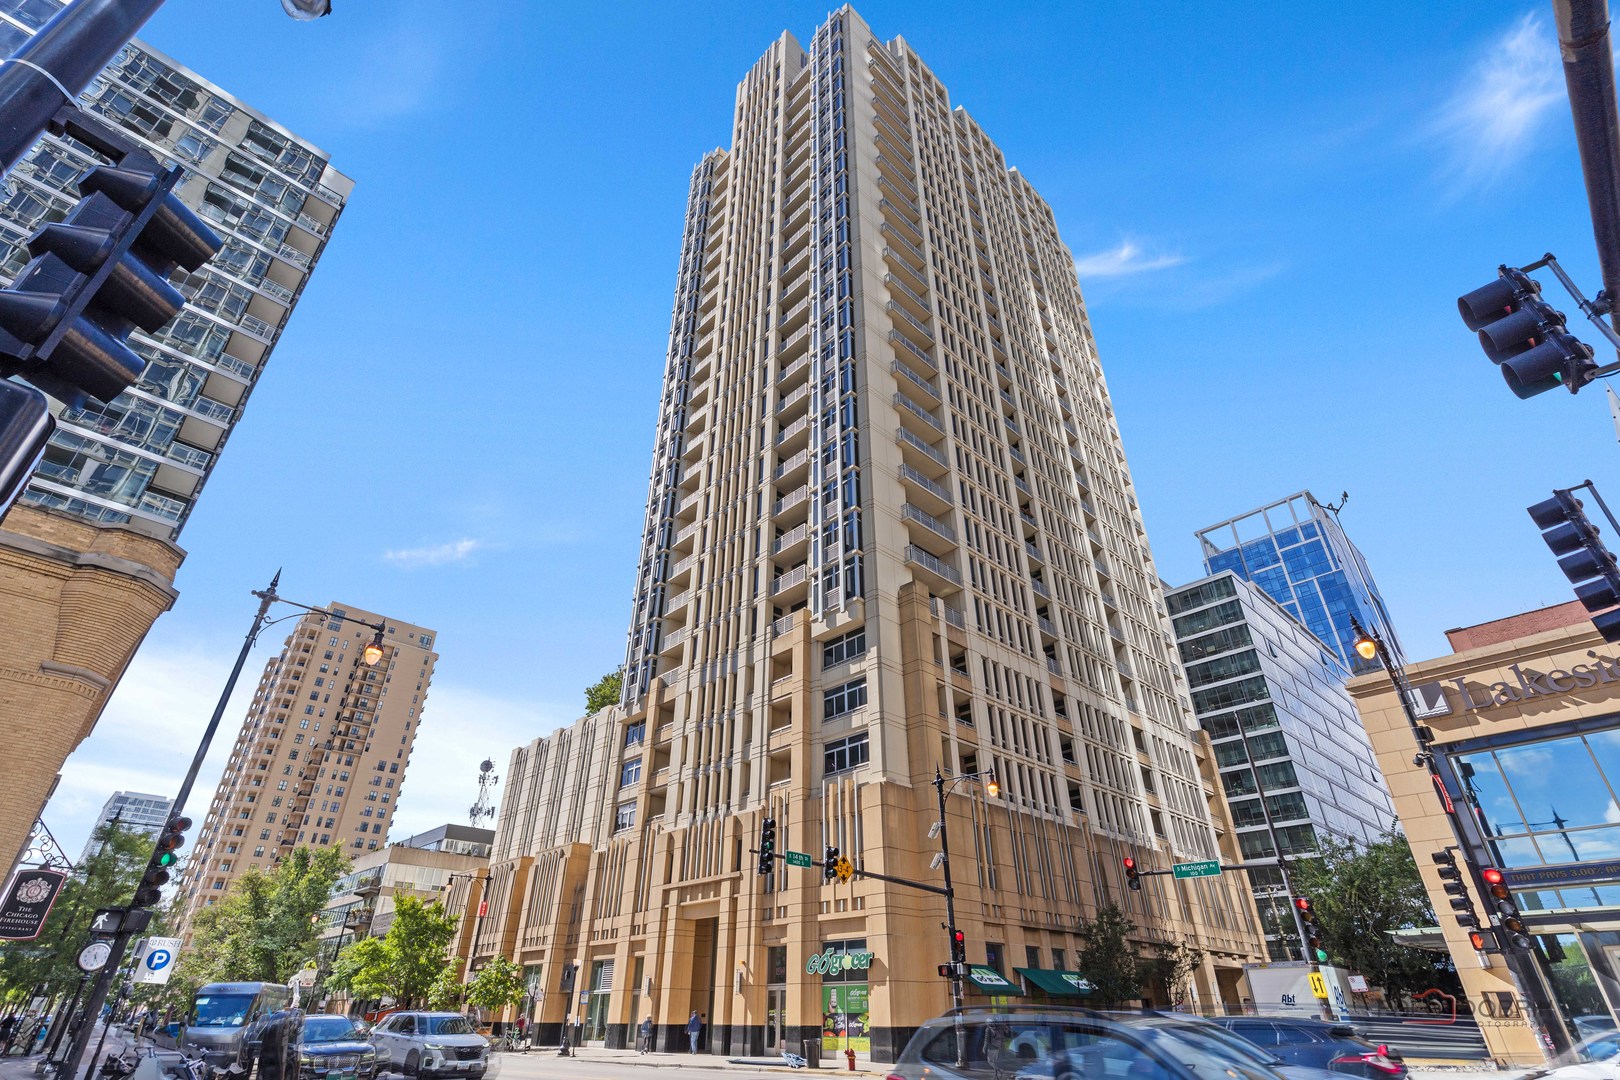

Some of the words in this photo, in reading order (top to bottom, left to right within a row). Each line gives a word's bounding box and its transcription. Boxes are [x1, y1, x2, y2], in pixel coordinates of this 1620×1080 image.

[1181, 864, 1209, 873] Michigan
[1511, 873, 1536, 882] THAT
[1538, 871, 1568, 880] PAYS
[1570, 867, 1604, 877] 3.00%
[1605, 864, 1620, 874] AP
[5, 911, 39, 919] CHICAGO
[0, 916, 39, 925] FIREHOUSE
[157, 939, 182, 948] RUSH
[150, 952, 168, 969] P
[1281, 994, 1296, 1003] Abt
